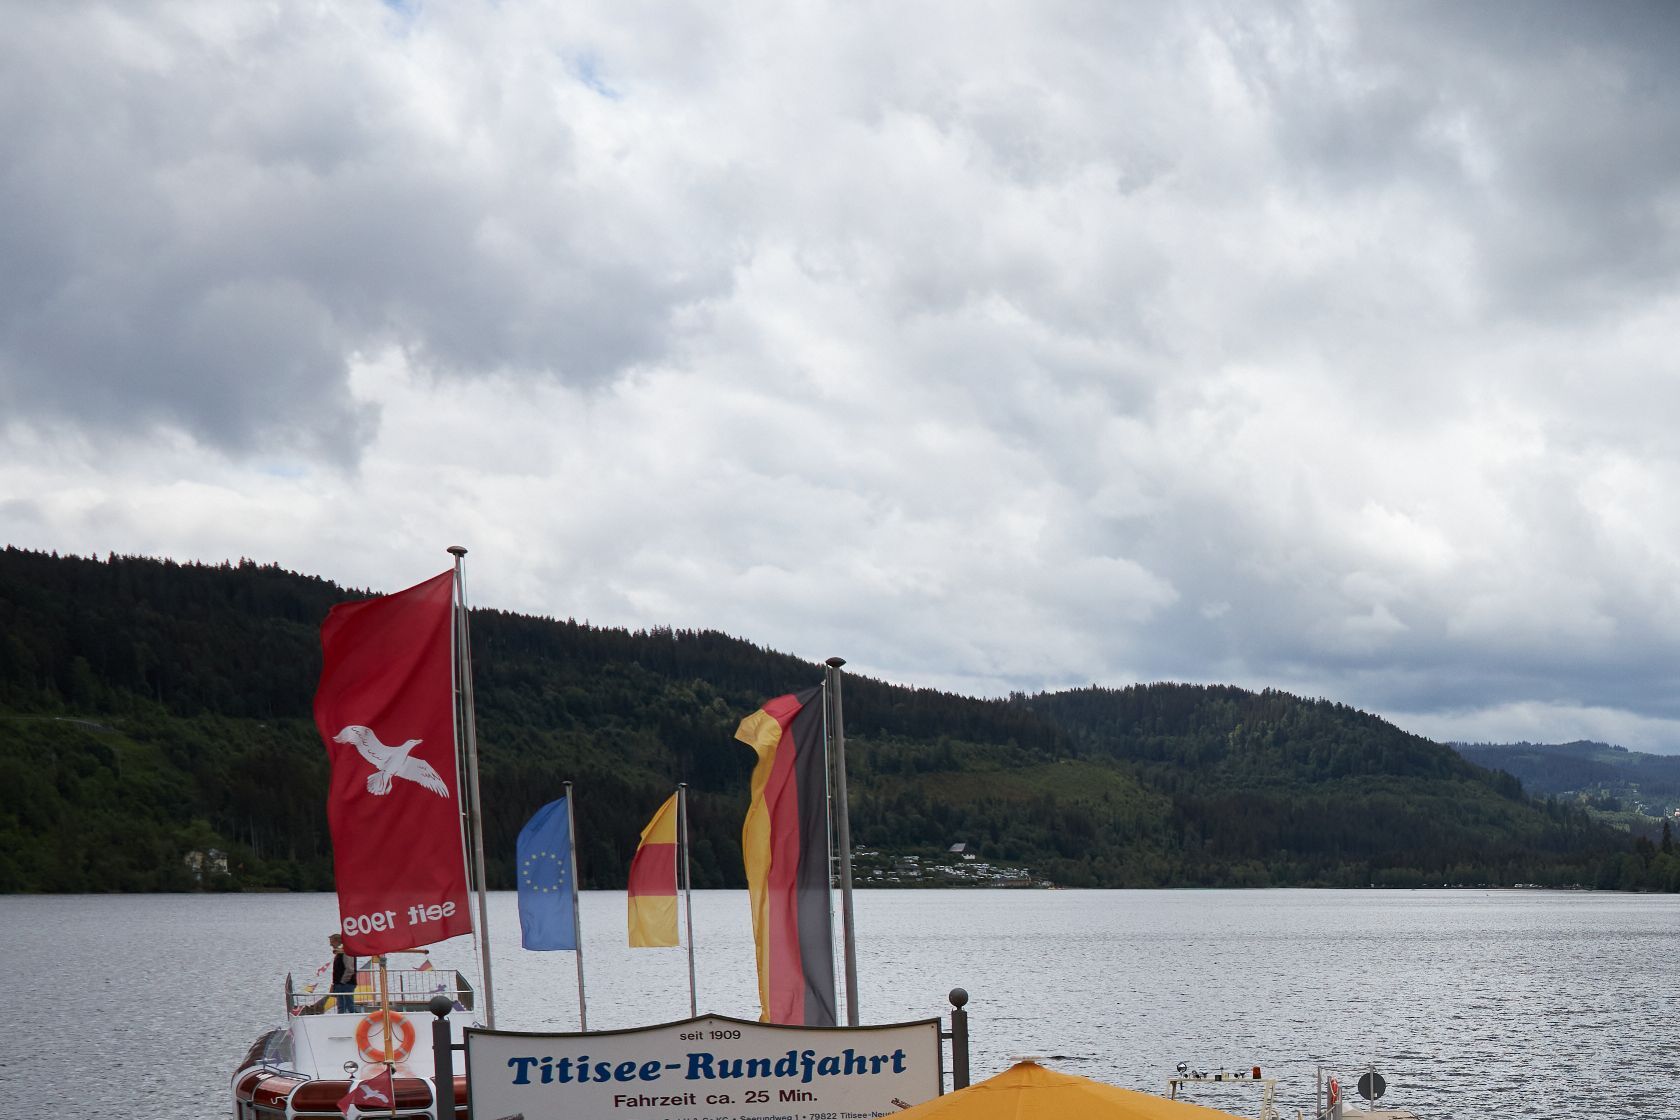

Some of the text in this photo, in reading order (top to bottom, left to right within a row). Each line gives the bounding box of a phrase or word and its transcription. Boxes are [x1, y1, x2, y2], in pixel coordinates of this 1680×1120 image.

[680, 1029, 741, 1041] seit 1909
[507, 1048, 907, 1085] Titisee-Rundfahrt
[614, 1089, 818, 1108] Fahrzeit ca. 25 Min.
[809, 1112, 837, 1120] 79822
